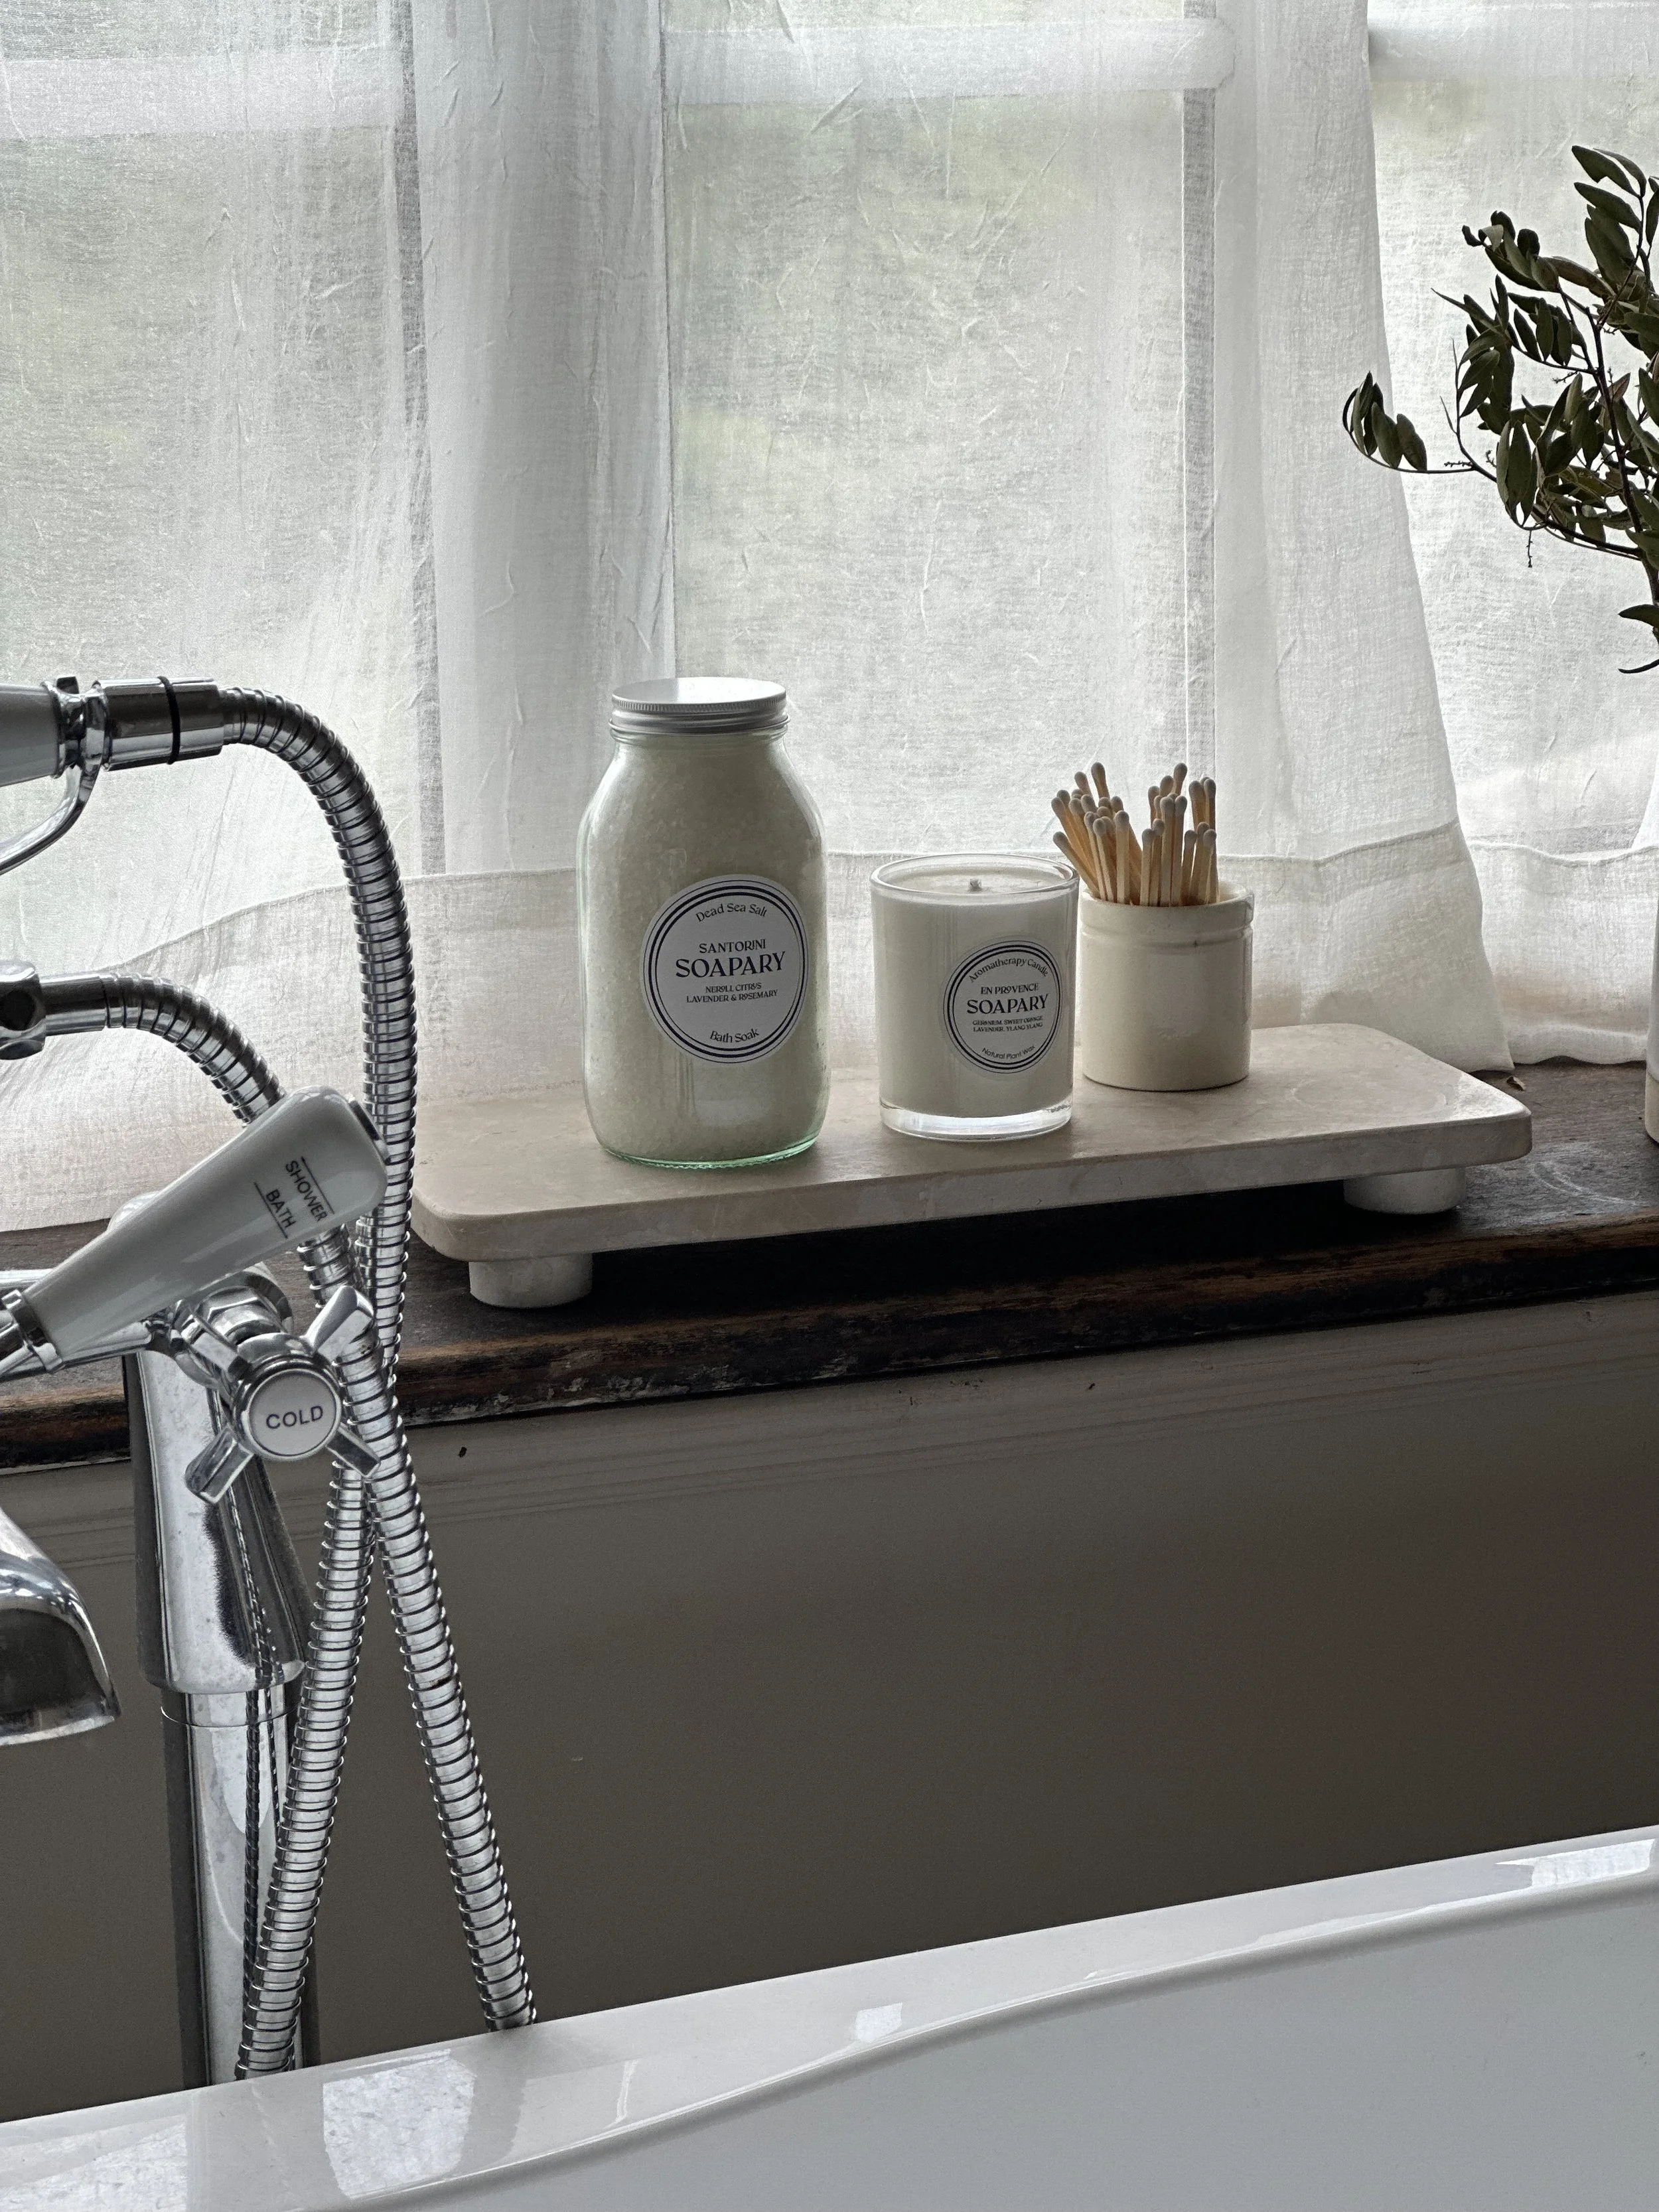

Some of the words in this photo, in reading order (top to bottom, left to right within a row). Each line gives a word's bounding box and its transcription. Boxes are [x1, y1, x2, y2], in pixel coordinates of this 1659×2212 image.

[695, 903, 724, 922] Dead
[727, 903, 746, 913] Sea
[749, 903, 767, 917] Salt
[699, 938, 766, 954] SANTORINI
[675, 951, 786, 978] SOAPARY
[968, 958, 1027, 983] Aromatherapy
[1027, 958, 1048, 978] Candle
[686, 994, 729, 1003] LAVENDER
[739, 989, 778, 1001] ROSEMARY
[735, 982, 762, 992] CITRUS
[981, 986, 993, 995] EN
[995, 983, 1039, 994] PROVENCE
[966, 993, 1049, 1014] SOAPARY
[709, 1031, 733, 1043] Bath
[735, 1028, 760, 1043] Soak
[981, 1047, 1005, 1059] Natural
[1022, 1045, 1035, 1054] Wax
[285, 1160, 328, 1222] SHOWER
[266, 1189, 297, 1228] BATH
[265, 1405, 324, 1430] COLD
